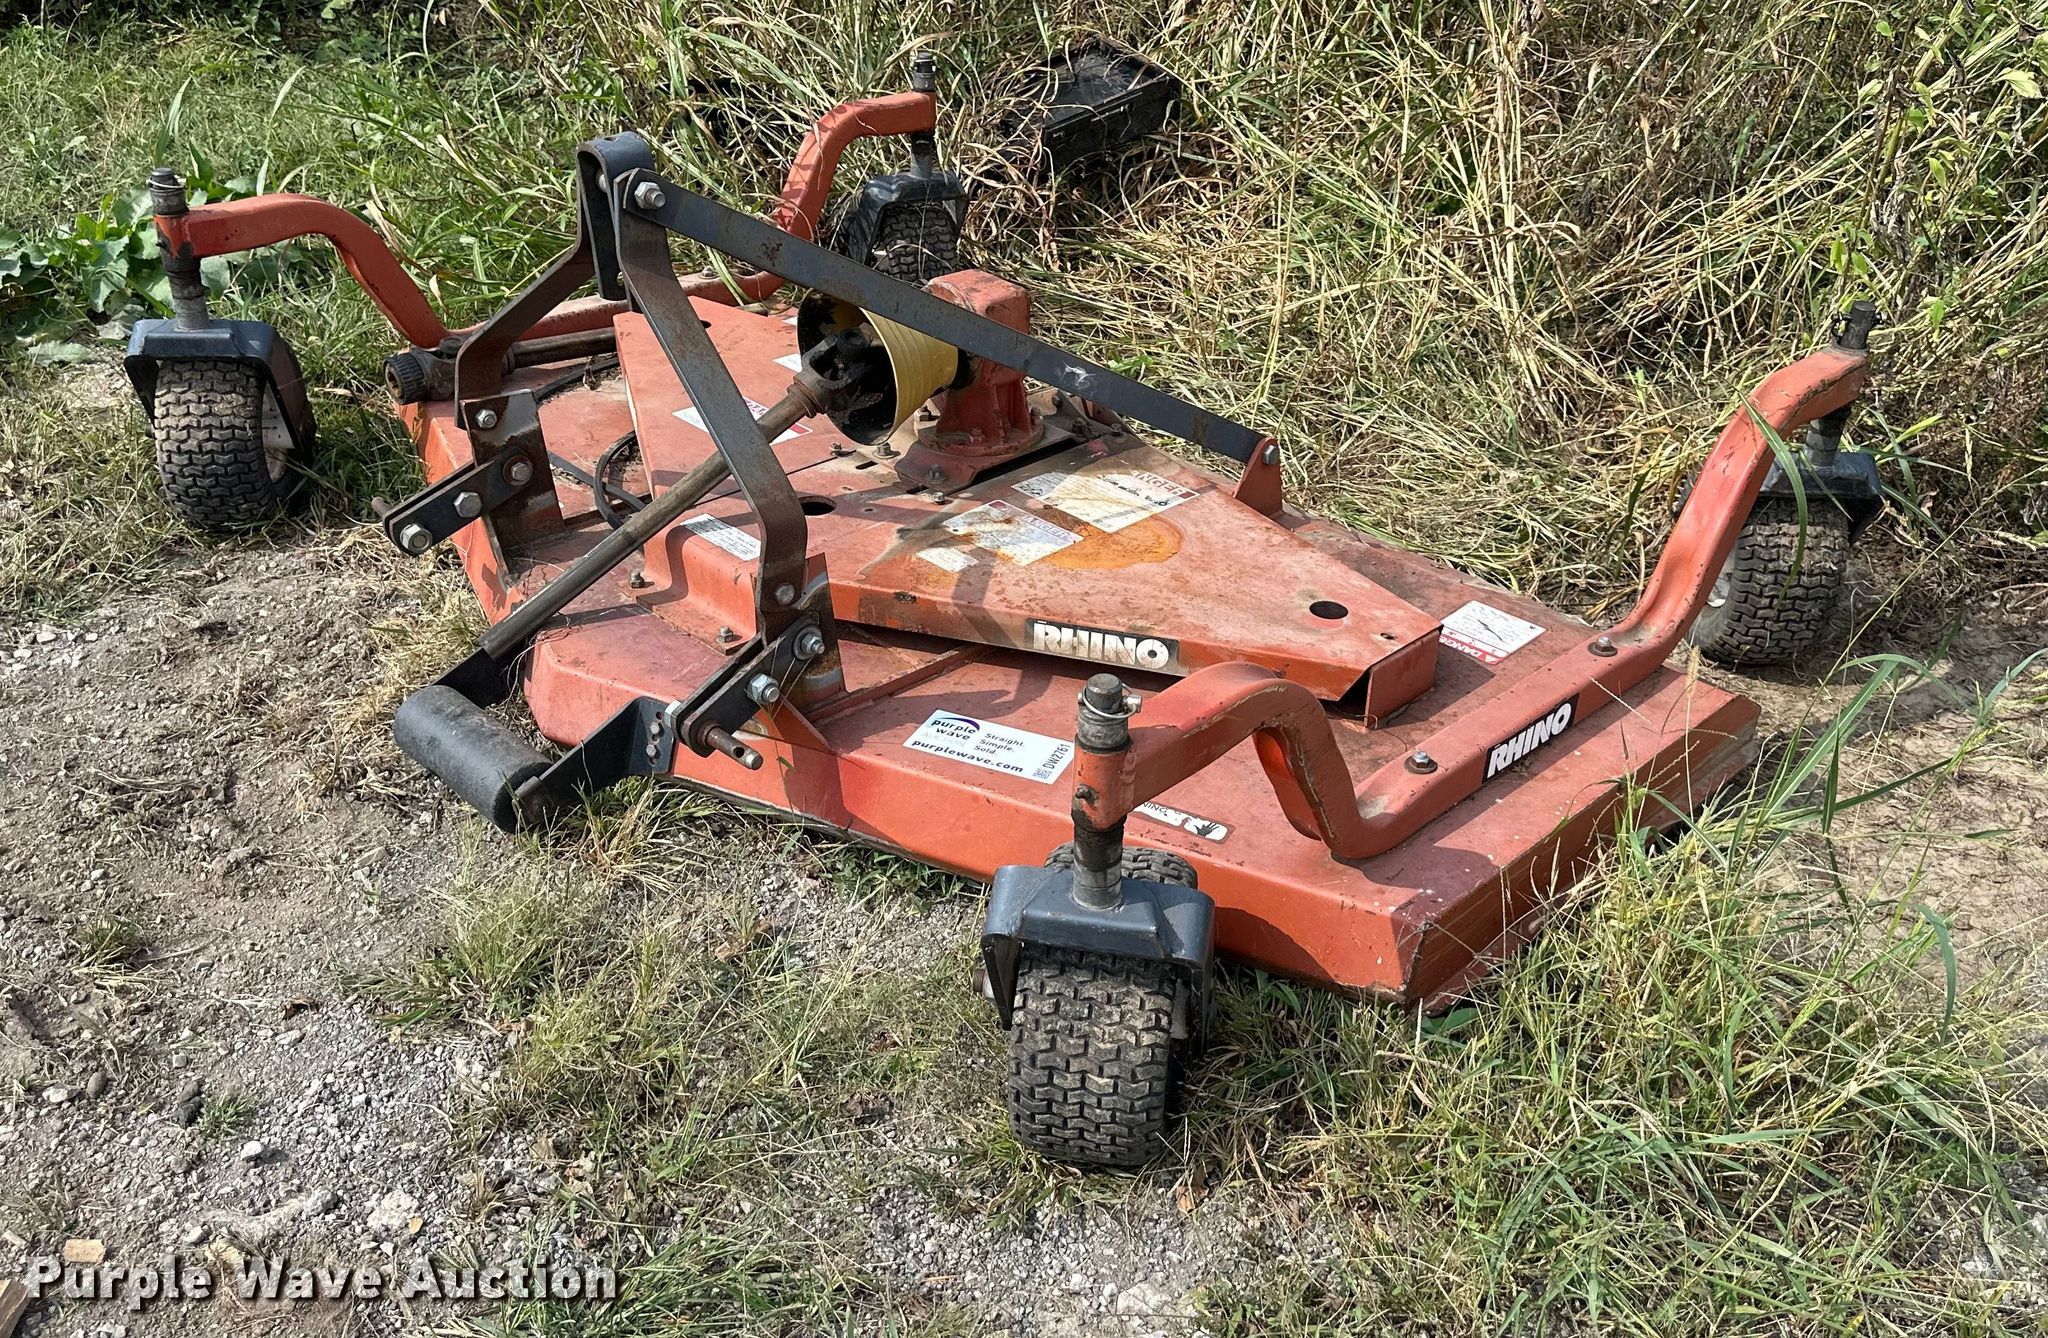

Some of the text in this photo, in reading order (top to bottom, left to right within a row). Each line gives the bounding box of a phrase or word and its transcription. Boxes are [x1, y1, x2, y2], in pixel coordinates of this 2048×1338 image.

[1033, 622, 1170, 669] RHINO
[931, 719, 977, 734] purple
[935, 728, 971, 741] wave
[974, 745, 998, 756] Sold.
[979, 738, 1015, 753] Simple.
[1487, 703, 1572, 779] RHINO
[912, 739, 1024, 773] purplewave.com
[1042, 743, 1072, 770] DW2761
